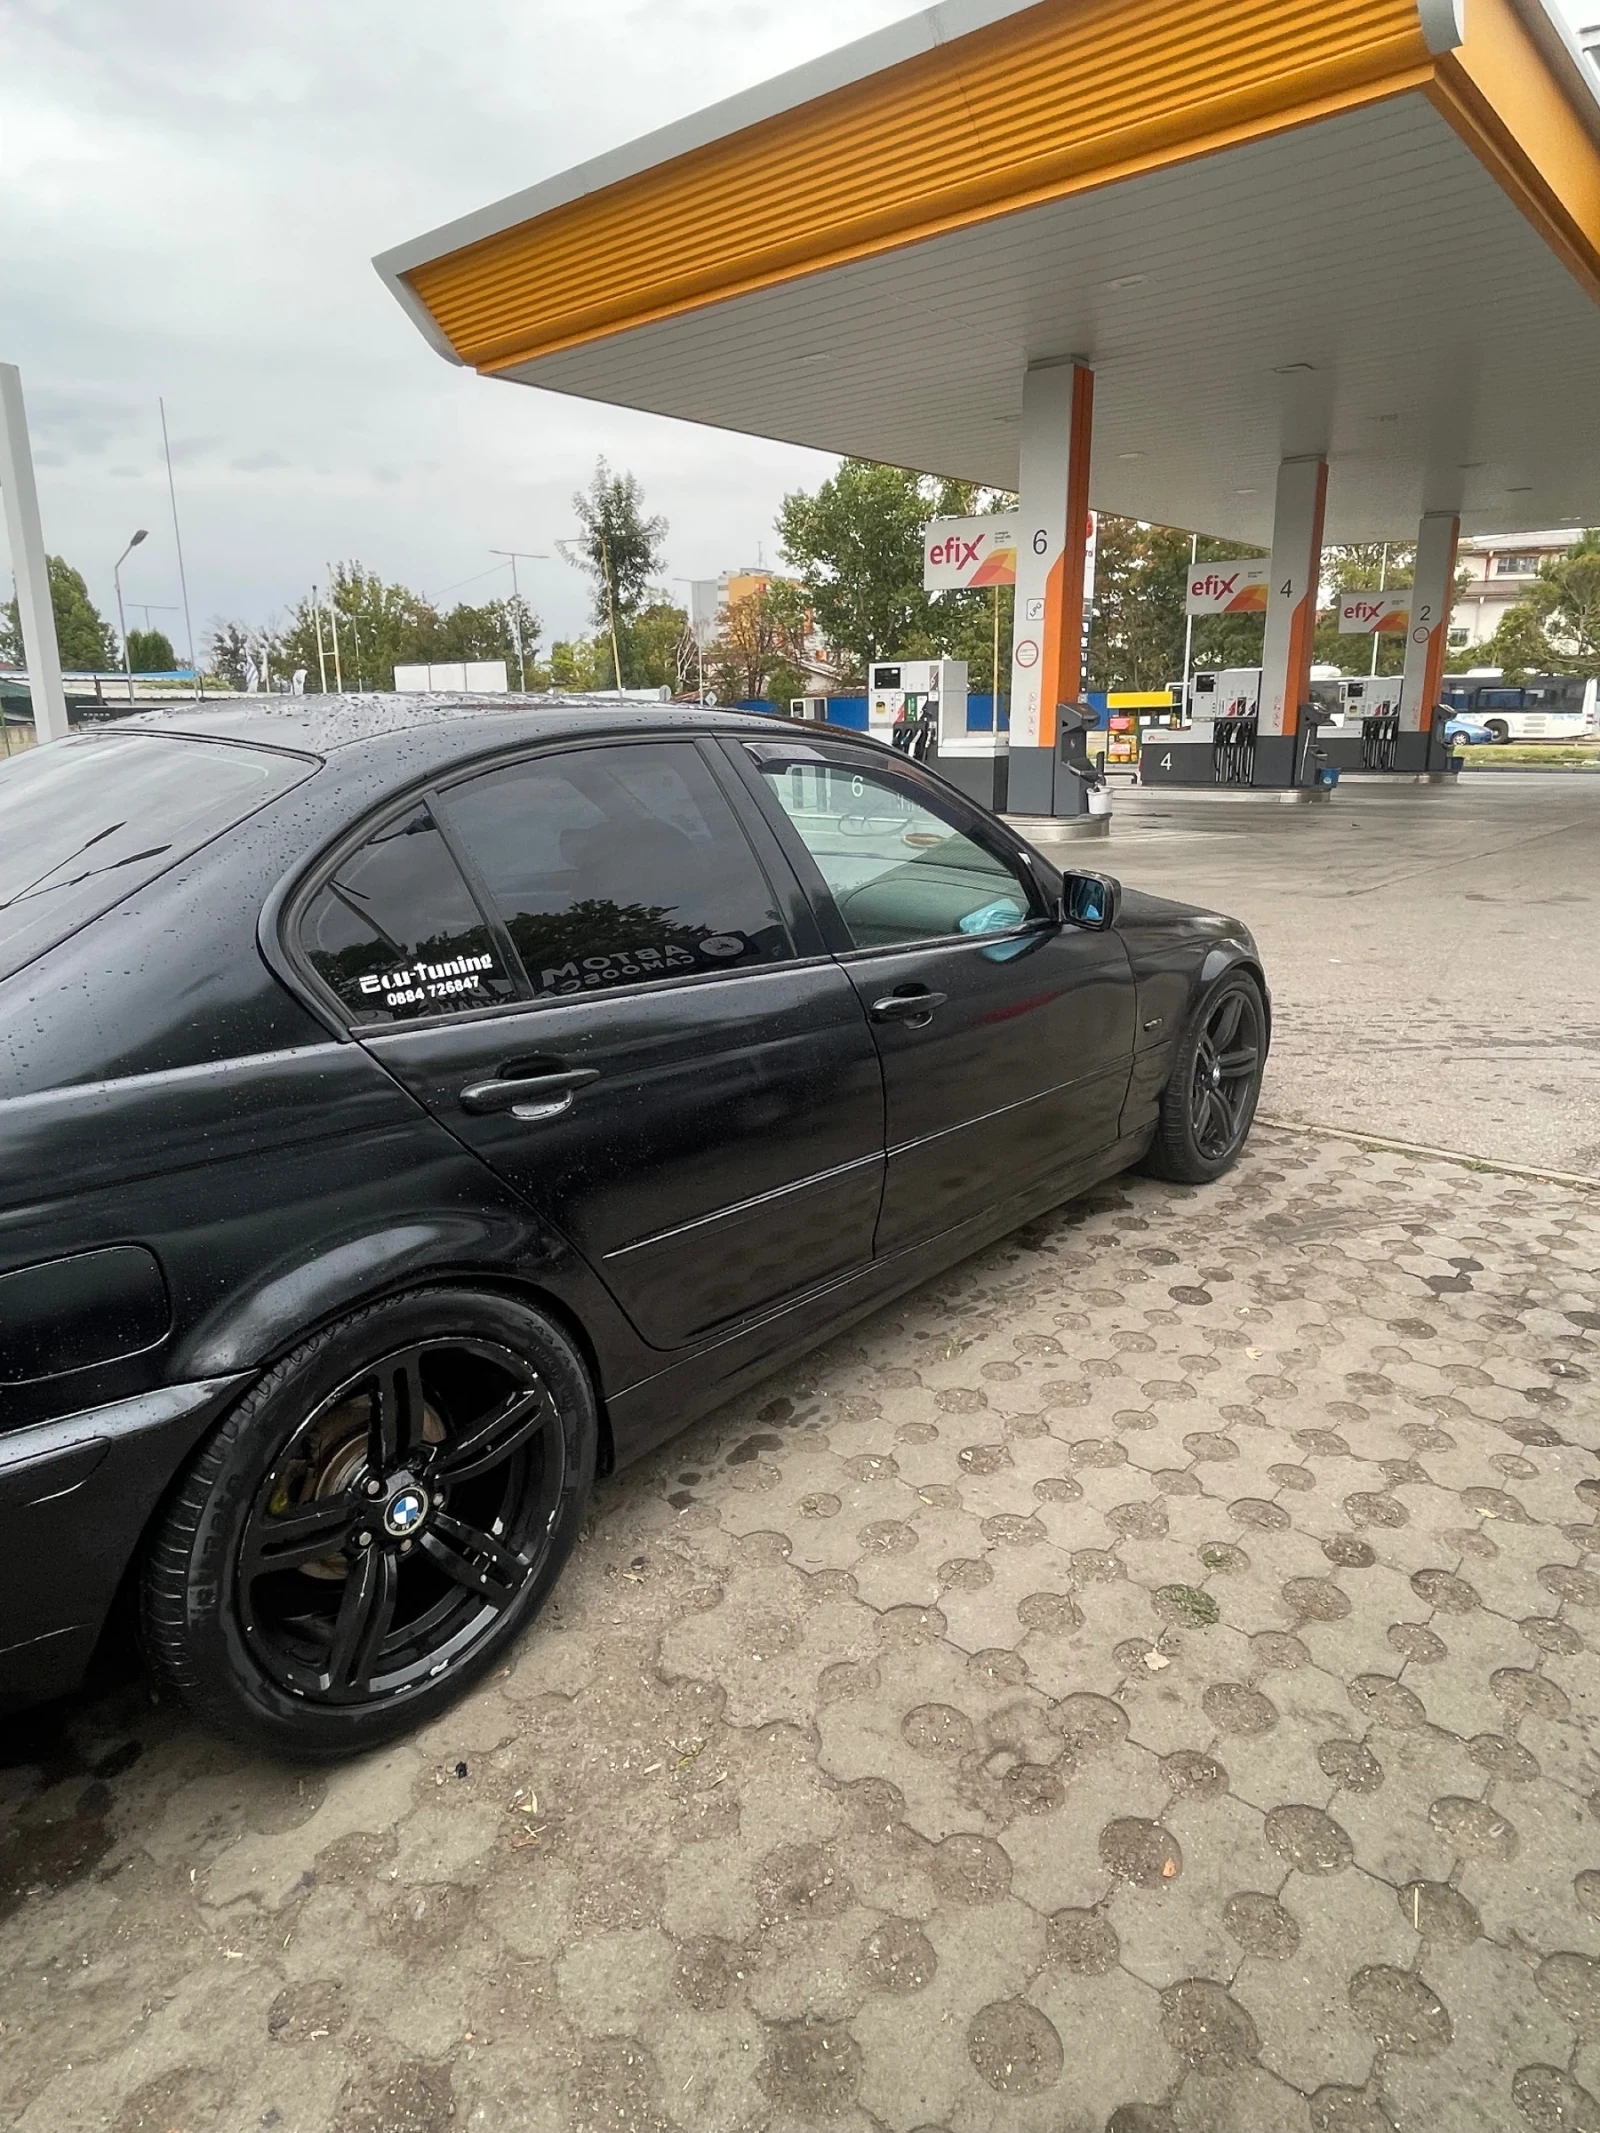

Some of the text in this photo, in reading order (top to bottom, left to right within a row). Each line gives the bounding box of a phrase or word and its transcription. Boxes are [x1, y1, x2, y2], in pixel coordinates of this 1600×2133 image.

[929, 533, 986, 571] efix
[1032, 529, 1048, 555] 6
[1191, 573, 1240, 600] efix
[1279, 578, 1293, 598] 4
[1344, 601, 1385, 622] efix
[1419, 605, 1431, 621] 2
[1160, 752, 1173, 771] 4
[851, 774, 864, 797] 6
[386, 988, 425, 1007] 0884
[427, 975, 480, 997] 726847
